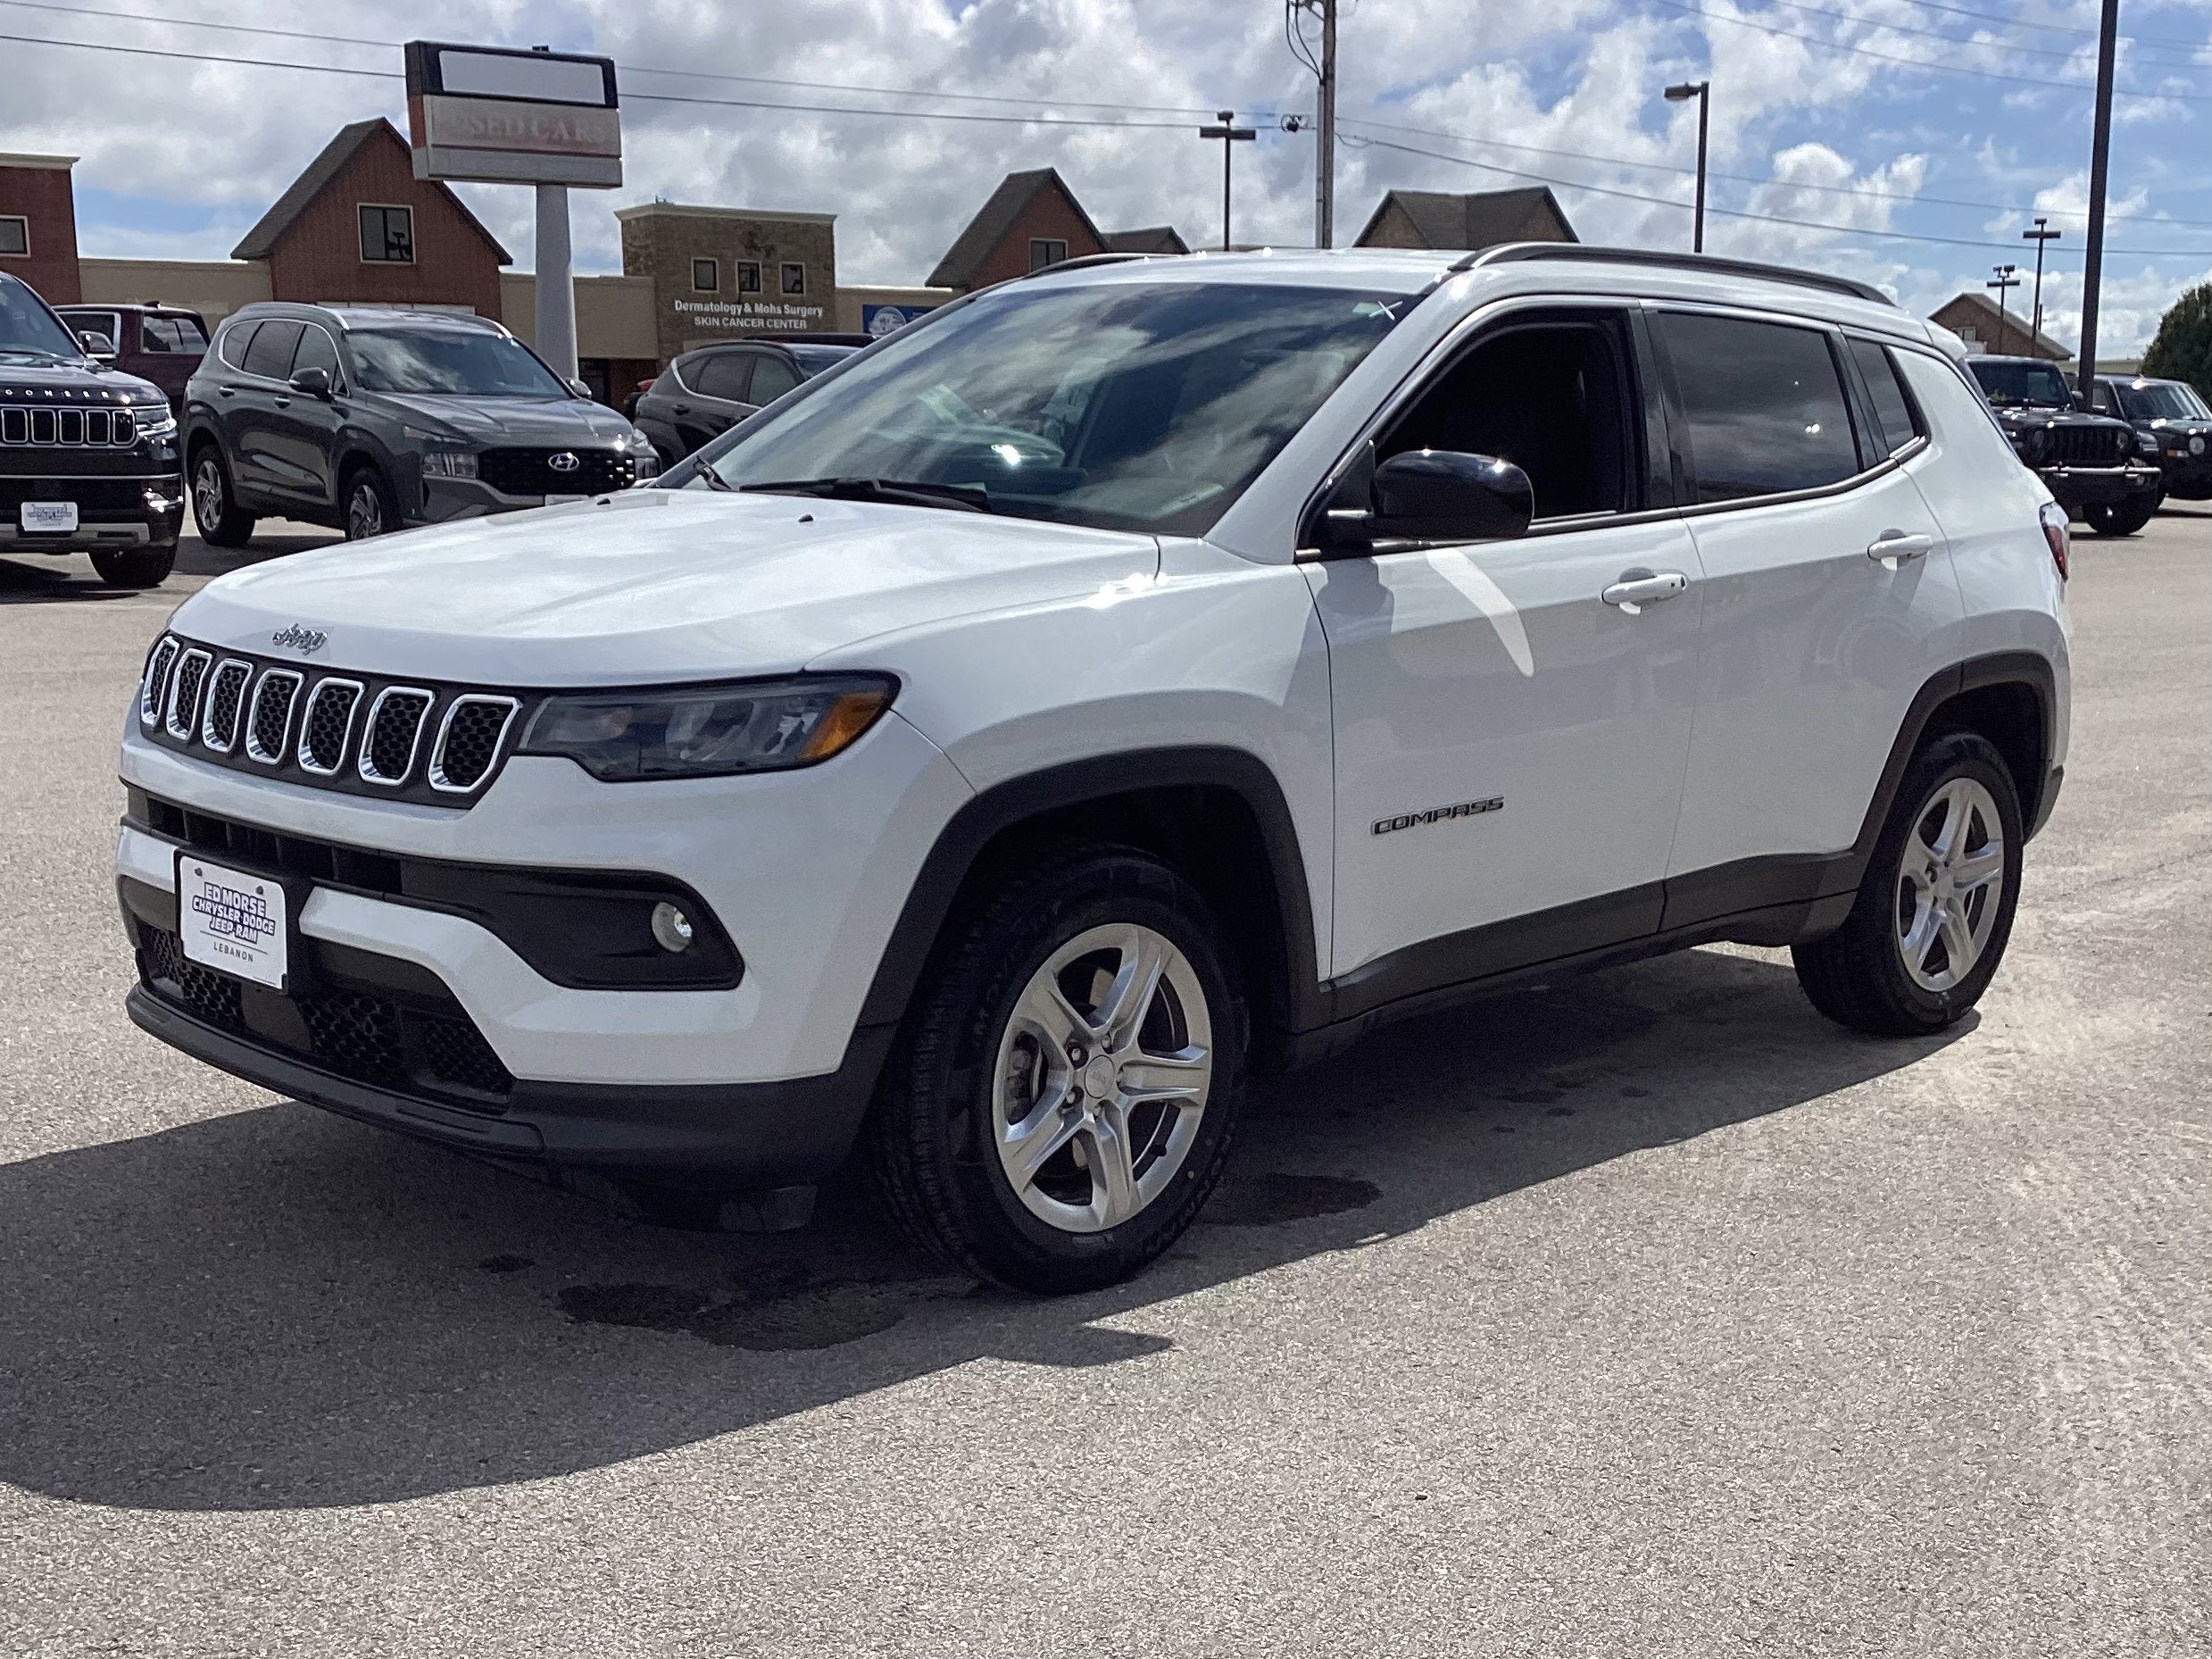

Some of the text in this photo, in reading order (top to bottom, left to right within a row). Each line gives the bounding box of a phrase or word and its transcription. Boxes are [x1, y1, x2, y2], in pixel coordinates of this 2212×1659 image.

[674, 300, 824, 319] Dermatology & Mohs Surgery
[694, 316, 807, 329] SKIN CANCER CENTER
[272, 622, 328, 656] Jeep
[1371, 796, 1504, 836] COMPASS
[204, 882, 266, 917] ED MORSE
[213, 941, 254, 963] LEBANON
